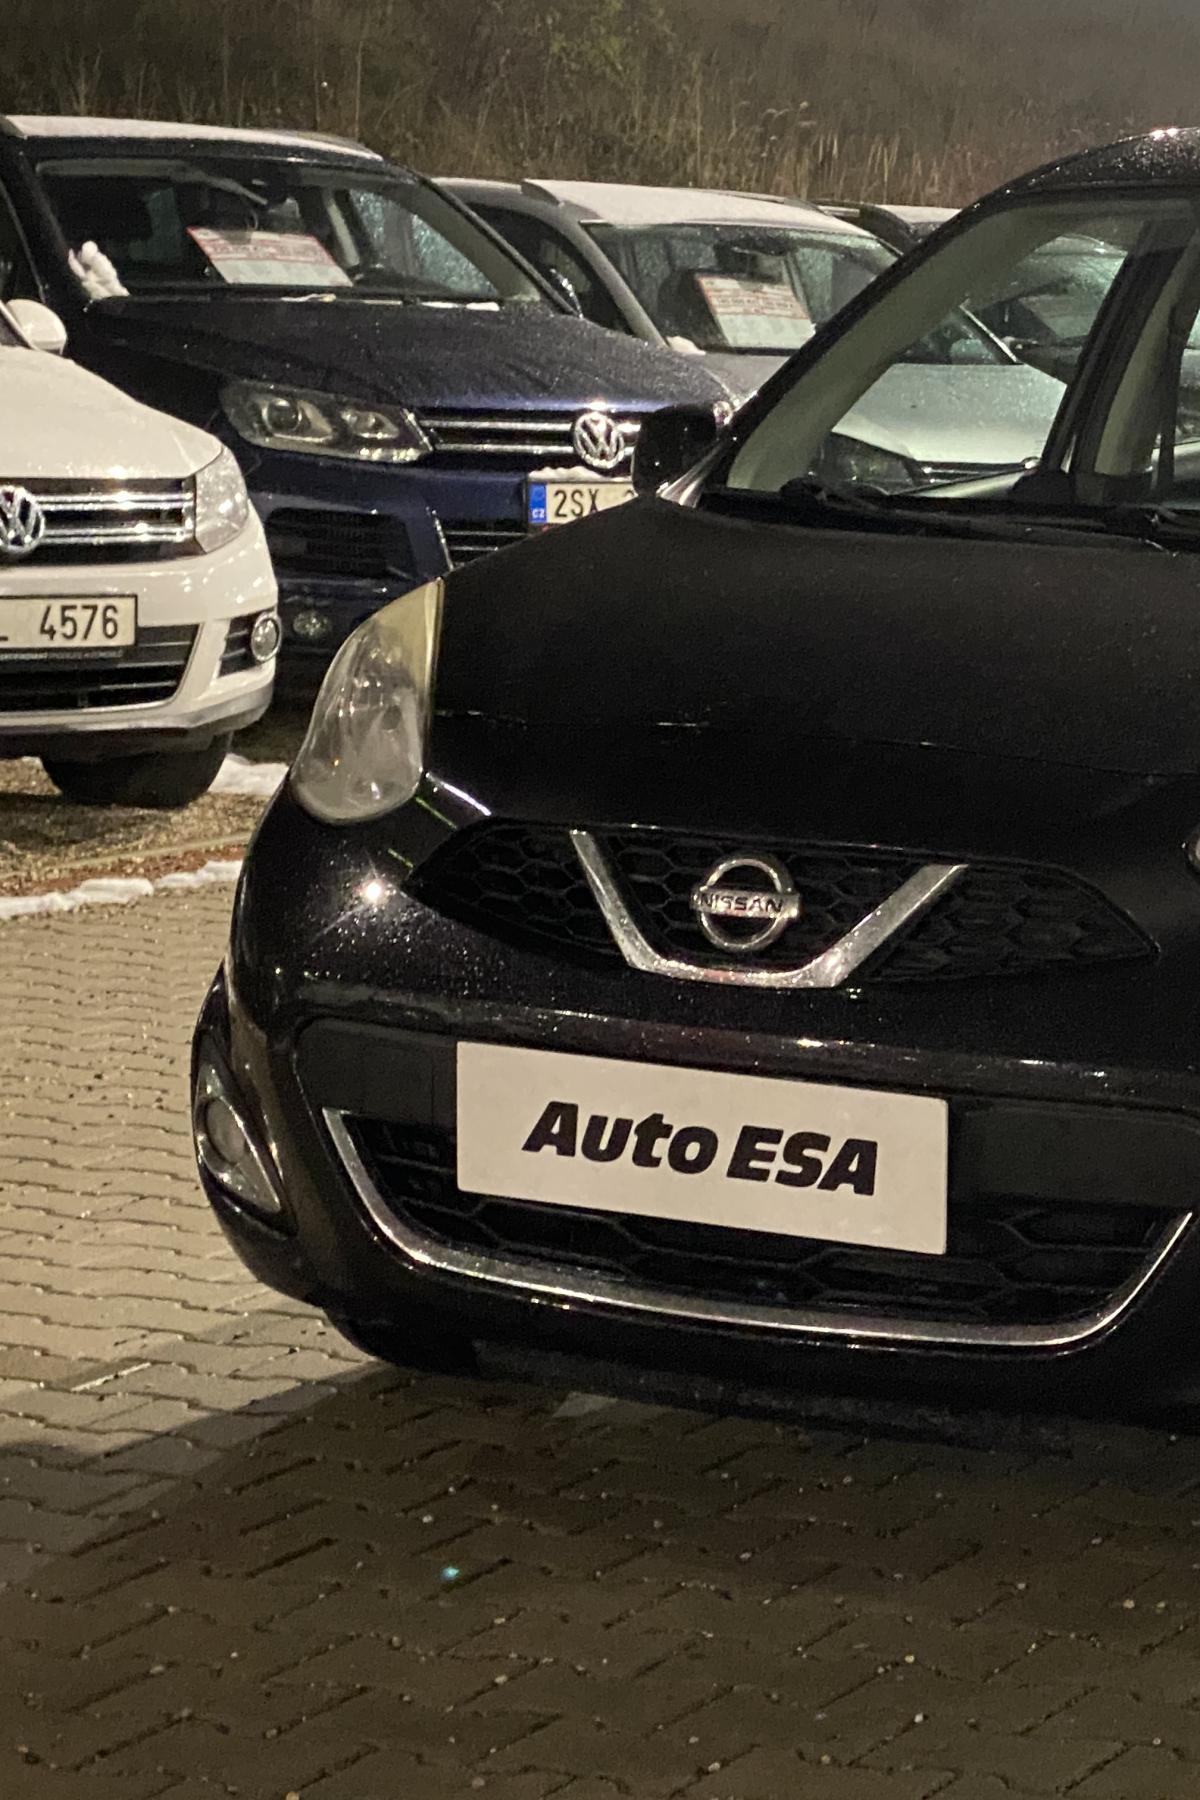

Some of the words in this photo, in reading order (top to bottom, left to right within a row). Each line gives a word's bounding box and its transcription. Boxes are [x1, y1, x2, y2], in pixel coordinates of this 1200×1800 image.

[39, 604, 118, 640] 4576
[701, 893, 783, 913] NISSAN
[521, 1100, 718, 1175] Auto
[726, 1125, 878, 1196] ESA
